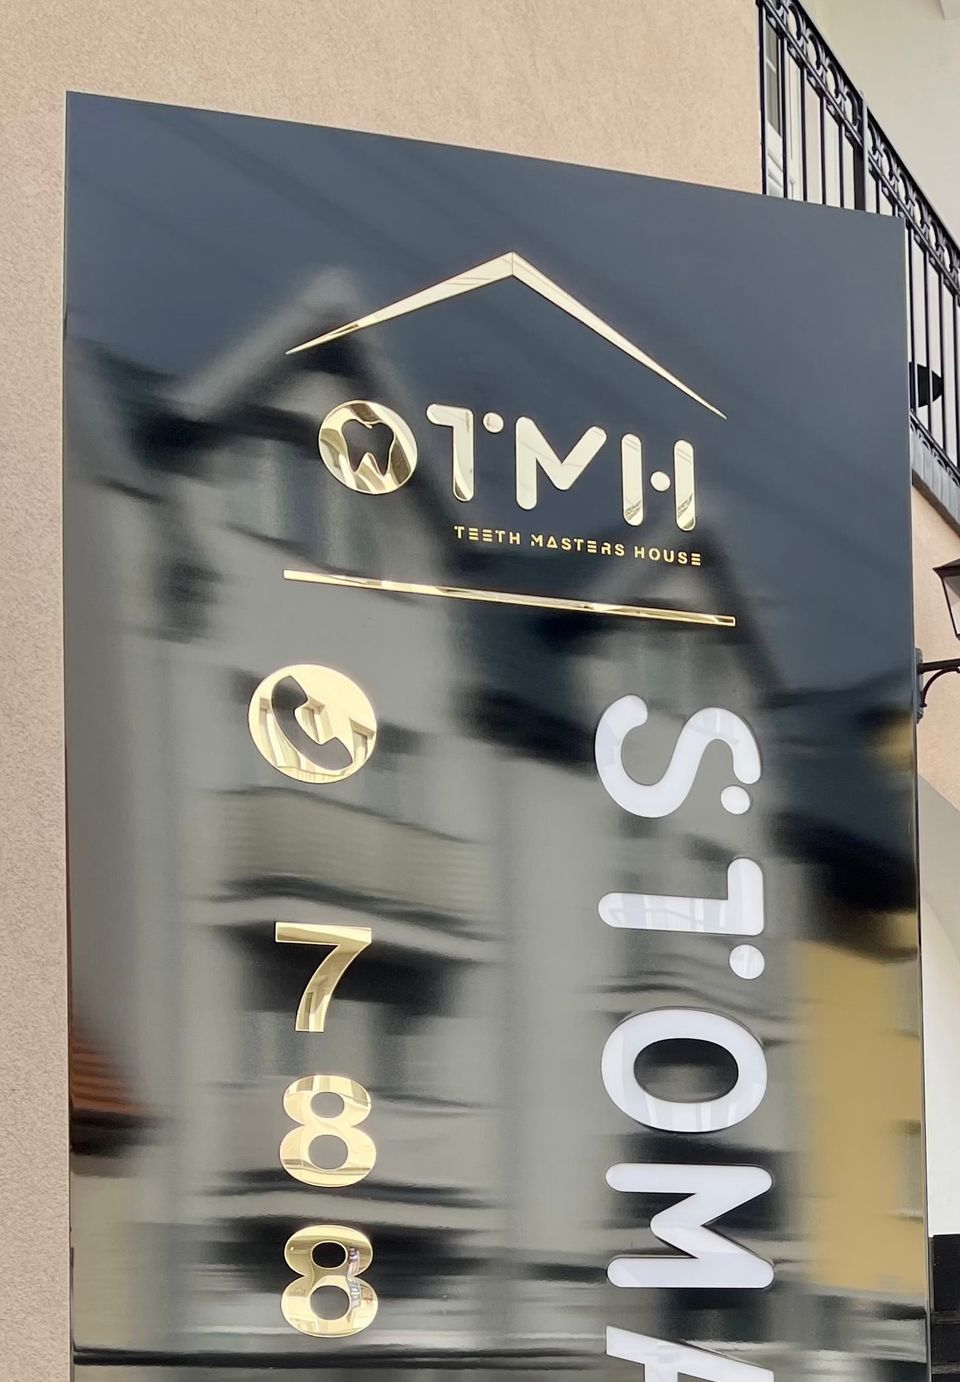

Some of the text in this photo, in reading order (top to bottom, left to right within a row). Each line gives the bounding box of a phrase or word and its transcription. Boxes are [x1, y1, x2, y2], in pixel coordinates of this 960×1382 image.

[453, 525, 701, 567] TEETH MASTERS HOUSE
